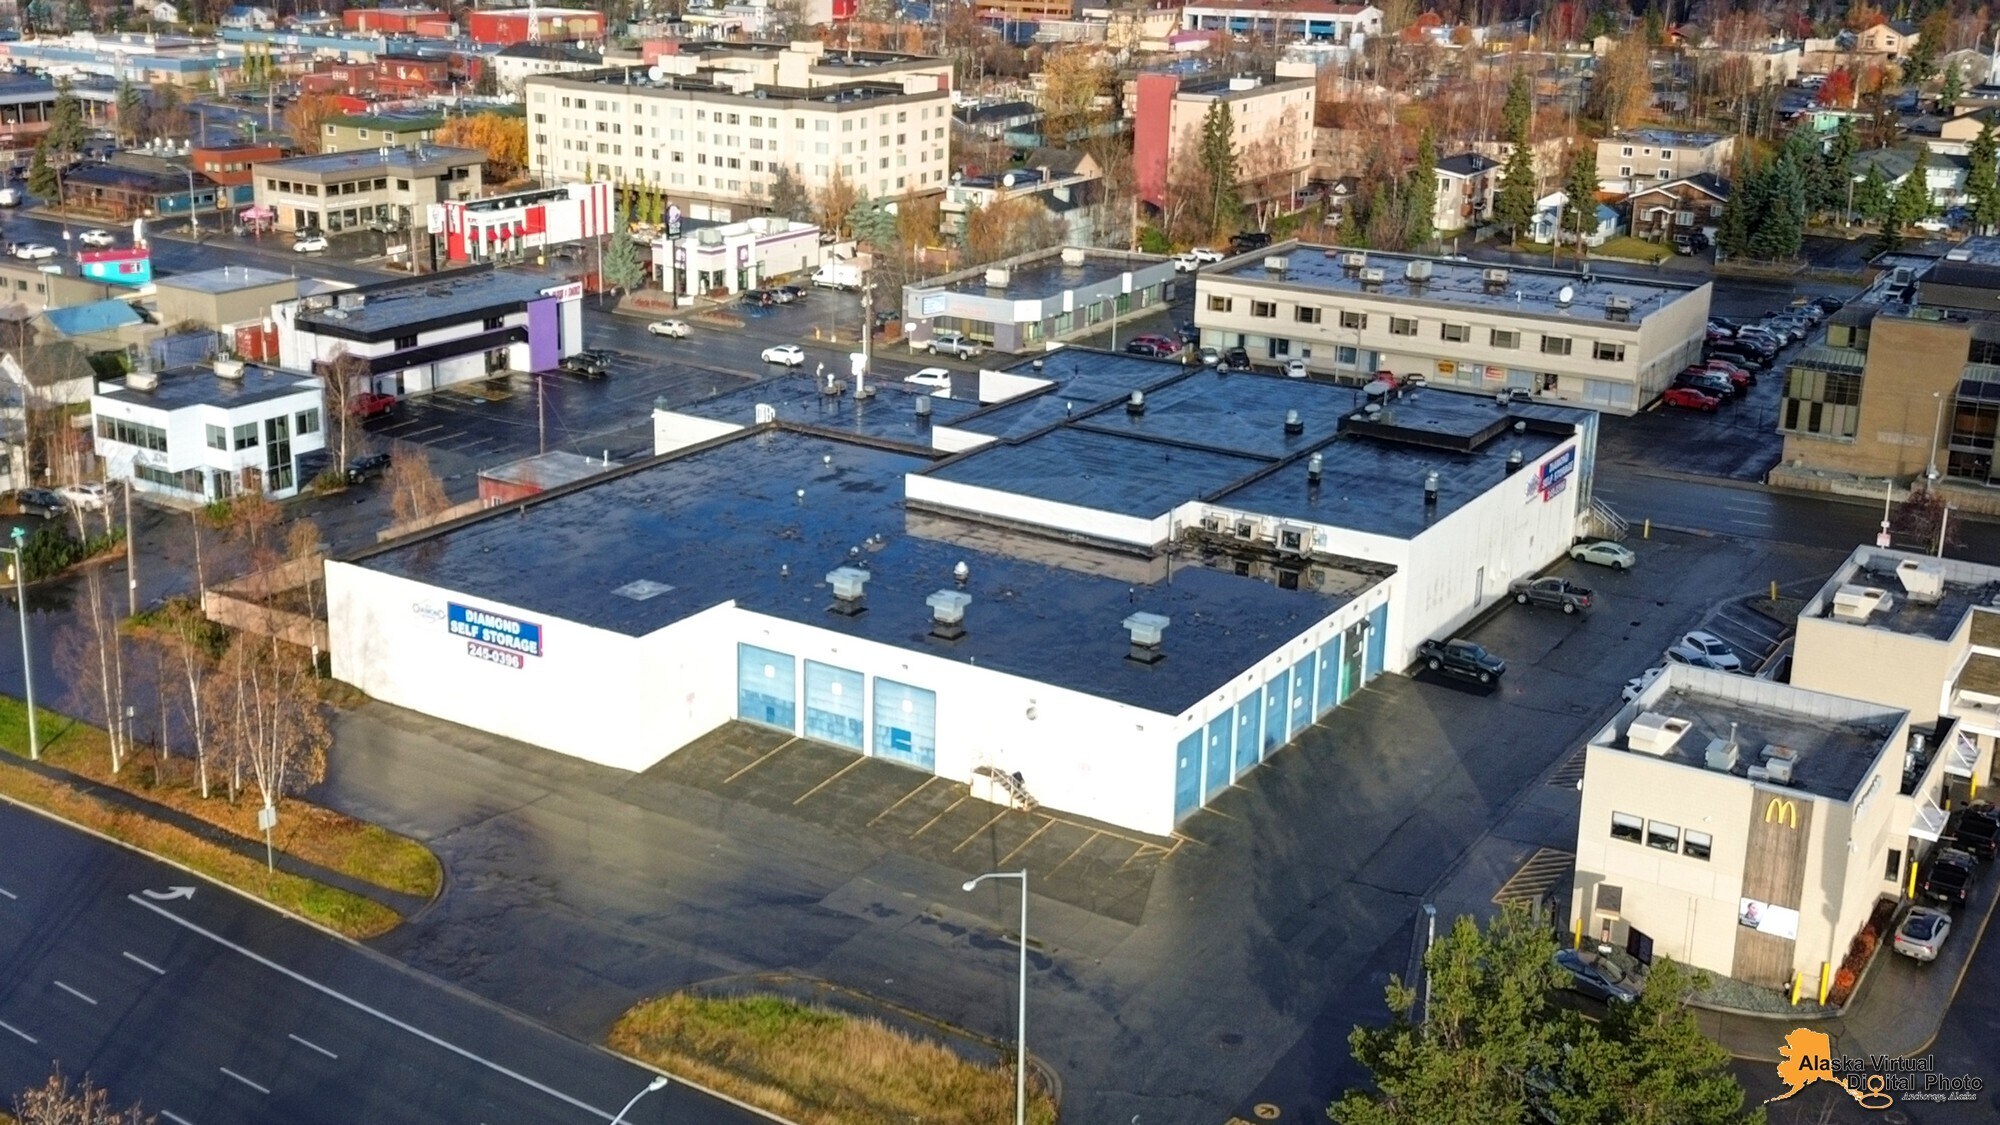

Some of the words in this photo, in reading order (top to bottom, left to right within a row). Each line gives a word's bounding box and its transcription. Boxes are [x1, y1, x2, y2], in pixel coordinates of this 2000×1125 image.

[465, 609, 520, 635] DIAMOND
[450, 620, 478, 638] SELF
[482, 628, 538, 654] STORAGE
[468, 643, 520, 669] 245-0396
